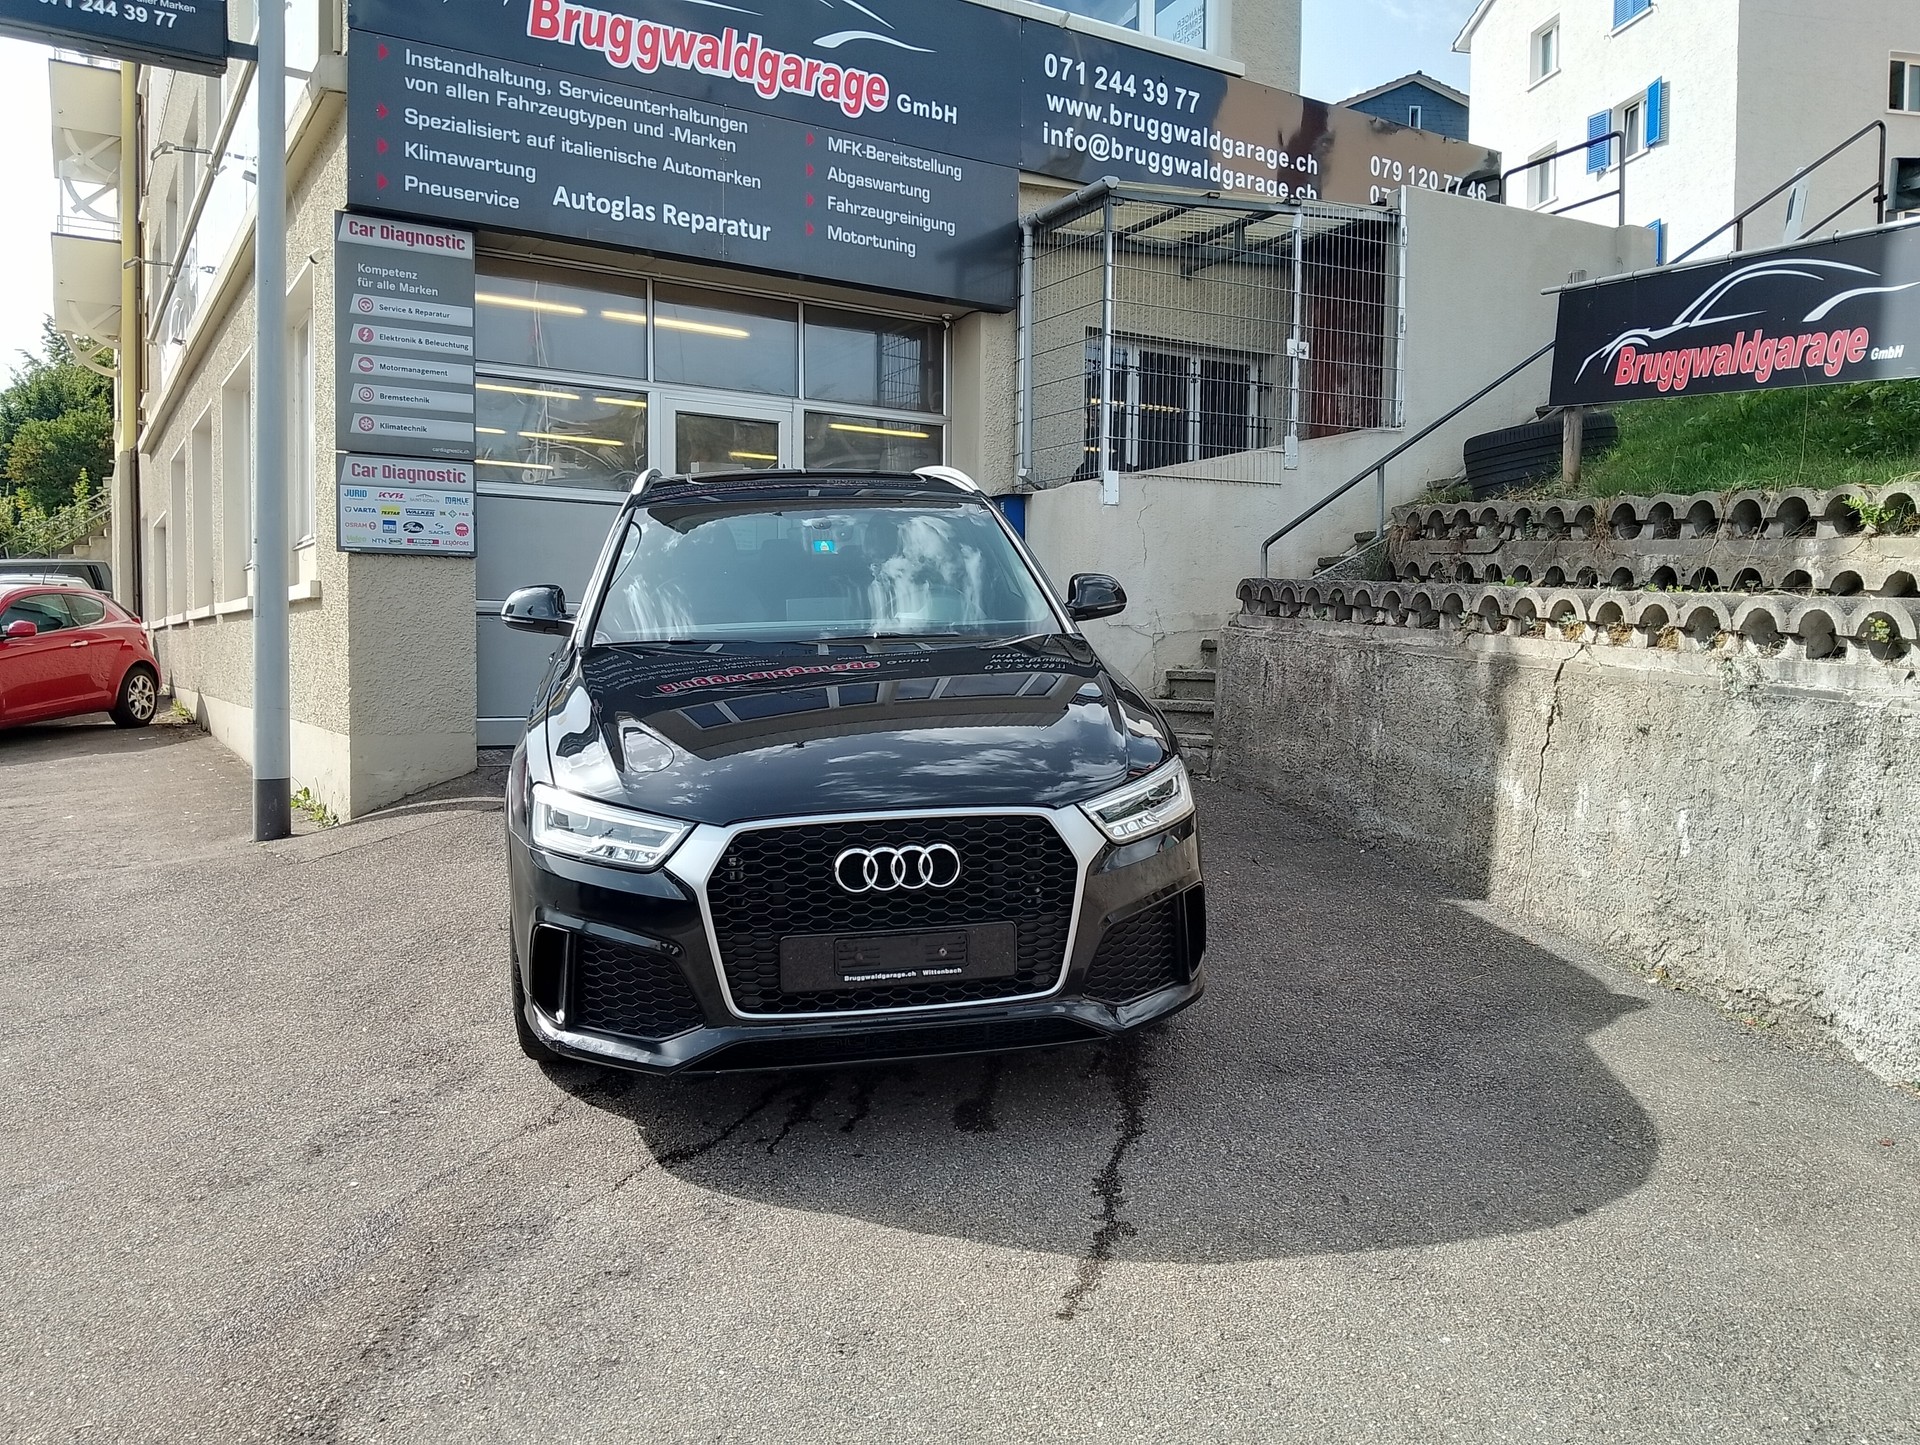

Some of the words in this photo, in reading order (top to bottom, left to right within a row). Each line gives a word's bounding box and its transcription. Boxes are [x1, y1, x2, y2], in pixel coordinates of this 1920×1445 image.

[80, 0, 119, 17] 244
[123, 4, 148, 23] 39
[153, 10, 177, 28] 77
[160, 0, 196, 13] Marken
[528, 0, 889, 118] Bruggwaldgarage
[897, 94, 958, 125] GmbH
[405, 48, 551, 96] Instandhaltung,
[558, 80, 748, 134] Serviceunterhaltungen
[1044, 53, 1085, 85] 071
[1095, 66, 1136, 98] 244
[1143, 79, 1168, 106] 39
[1175, 87, 1200, 114] 77
[404, 77, 438, 95] von
[446, 83, 489, 104] allen
[496, 90, 627, 131] Fahrzeugtypen
[633, 120, 664, 138] und
[669, 127, 736, 153] -Marken
[404, 108, 520, 144] Spezialisiert
[526, 134, 555, 150] auf
[560, 137, 658, 169] italienische
[662, 156, 761, 189] Automarken
[1046, 93, 1318, 175] www.bruggwaldgarage.ch
[404, 141, 537, 183] Klimawartung
[827, 136, 962, 181] MFK-Bereitstellung
[1042, 122, 1317, 199] info@bruggwaldgarage.ch
[404, 175, 520, 210] Pneuservice
[827, 166, 931, 203] Abgaswartung
[1370, 155, 1402, 181] 079
[1408, 165, 1438, 190] 120
[1444, 174, 1463, 197] 77
[1467, 181, 1487, 201] 46
[553, 185, 656, 222] Autoglas
[663, 204, 772, 242] Reparatur
[827, 196, 956, 236] Fahrzeugreinigung
[348, 220, 376, 238] Car
[380, 225, 465, 250] Diagnostic
[827, 225, 916, 258] Motortuning
[357, 263, 418, 280] Kompetenz
[357, 277, 373, 288] für
[376, 281, 396, 291] alle
[399, 283, 438, 297] Marken
[379, 304, 406, 314] Service
[415, 309, 450, 319] Reparatur
[380, 333, 416, 344] Elektronik
[425, 339, 469, 351] Beleuchtung
[1614, 326, 1869, 392] Bruggwaldgarage
[1870, 344, 1904, 361] GmbH
[380, 363, 448, 376] Motormanagement
[380, 393, 430, 404] Bremstechnik
[380, 422, 427, 433] Klimatechnik
[351, 463, 378, 478] Car
[382, 464, 466, 484] Diagnostic
[844, 971, 917, 981] Bruggwaldgarage.ch
[922, 968, 962, 976] Wittenbach
